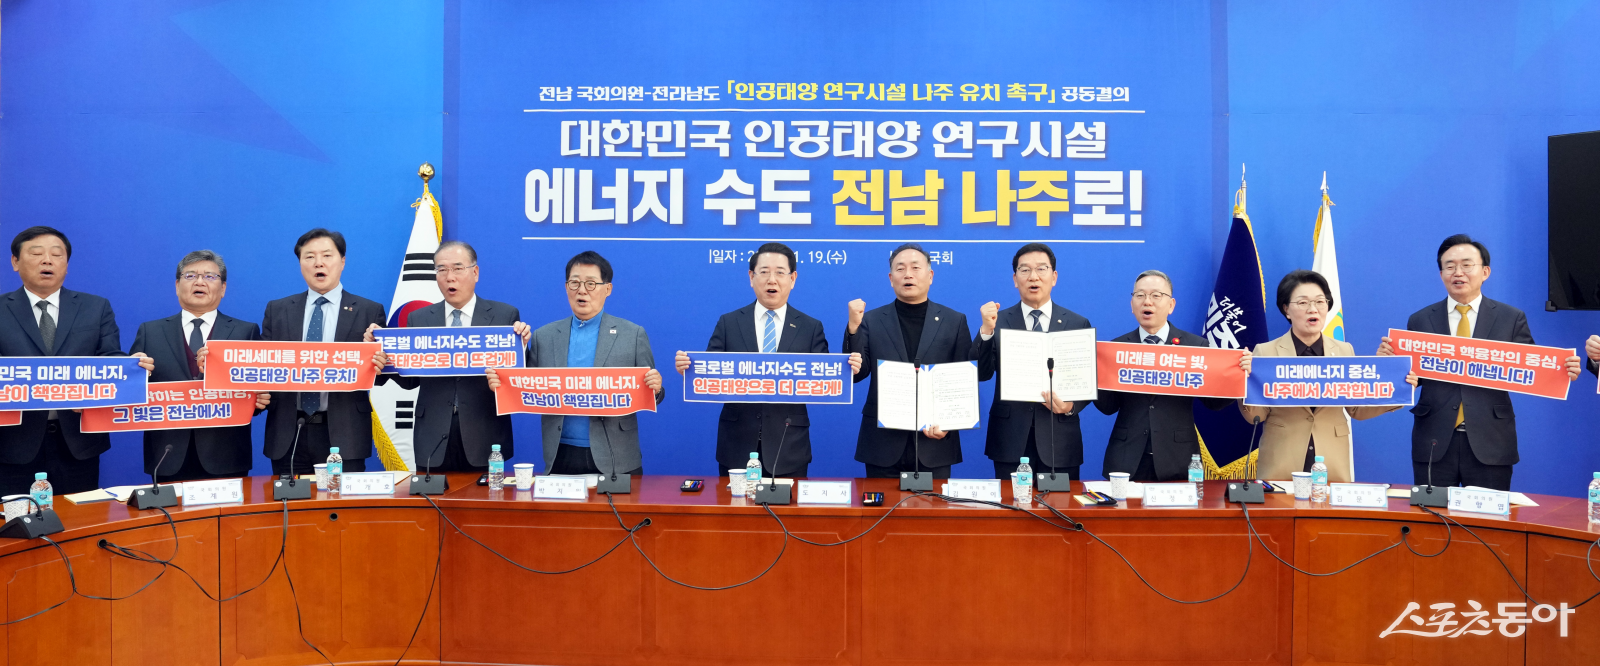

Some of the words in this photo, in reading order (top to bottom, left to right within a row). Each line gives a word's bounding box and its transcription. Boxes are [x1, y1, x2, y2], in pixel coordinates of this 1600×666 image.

[539, 86, 573, 102] 전남
[577, 86, 720, 102] 국회의원-전라남도
[727, 80, 818, 101] 「인공태양
[823, 82, 906, 101] 연구시설
[912, 82, 954, 101] 나주
[959, 82, 1001, 102] 유치
[1006, 82, 1056, 103] 촉구」
[1061, 86, 1130, 102] 공동결의
[560, 119, 732, 158] 대한민국
[743, 119, 921, 158] 인공태양
[932, 120, 1106, 159] 연구시설
[524, 167, 684, 225] 에너지
[703, 168, 812, 226] 수도
[832, 168, 945, 227] 전남
[961, 168, 1143, 228] 나주로!
[808, 249, 848, 265] 19.(수)
[929, 250, 953, 265] 국회
[414, 335, 482, 350] 에너지수도
[484, 334, 517, 349] 전남!
[223, 348, 296, 364] 미래세대를
[299, 349, 330, 365] 위한
[332, 350, 365, 366] 선택,
[453, 351, 468, 368] 더
[470, 351, 518, 369] 뜨겁게!
[1115, 350, 1156, 367] 미래를
[1159, 353, 1187, 369] 여는
[1190, 355, 1208, 371] 빛,
[1398, 338, 1456, 358] 대한민국
[1459, 345, 1522, 365] 핵융합의
[1525, 352, 1562, 371] 중심,
[37, 365, 71, 381] 미래
[75, 365, 129, 381] 에너지,
[229, 366, 290, 384] 인공태양
[291, 367, 322, 384] 나주
[323, 367, 358, 384] 유치!
[693, 360, 735, 376] 글로벌
[738, 360, 807, 377] 에너지수도
[810, 361, 843, 377] 전남!
[1275, 364, 1345, 379] 미래에너지
[1348, 364, 1381, 380] 중심,
[1419, 355, 1465, 376] 전남이
[1467, 362, 1536, 386] 해냅니다!
[508, 375, 562, 390] 대한민국
[565, 375, 592, 390] 미래
[595, 375, 641, 390] 에너지,
[693, 378, 776, 396] 인공태양으로
[778, 379, 794, 396] 더
[795, 379, 843, 397] 뜨겁게!
[1118, 368, 1173, 387] 인공태양
[1175, 371, 1205, 390] 나주
[31, 383, 118, 402] 책임집니다
[1263, 382, 1321, 399] 나주에서
[1322, 381, 1396, 399] 시작합니다
[521, 391, 561, 408] 전남이
[563, 393, 633, 409] 책임집니다
[113, 406, 130, 424] 그
[133, 404, 164, 423] 빛은
[167, 402, 232, 422] 전남에서!
